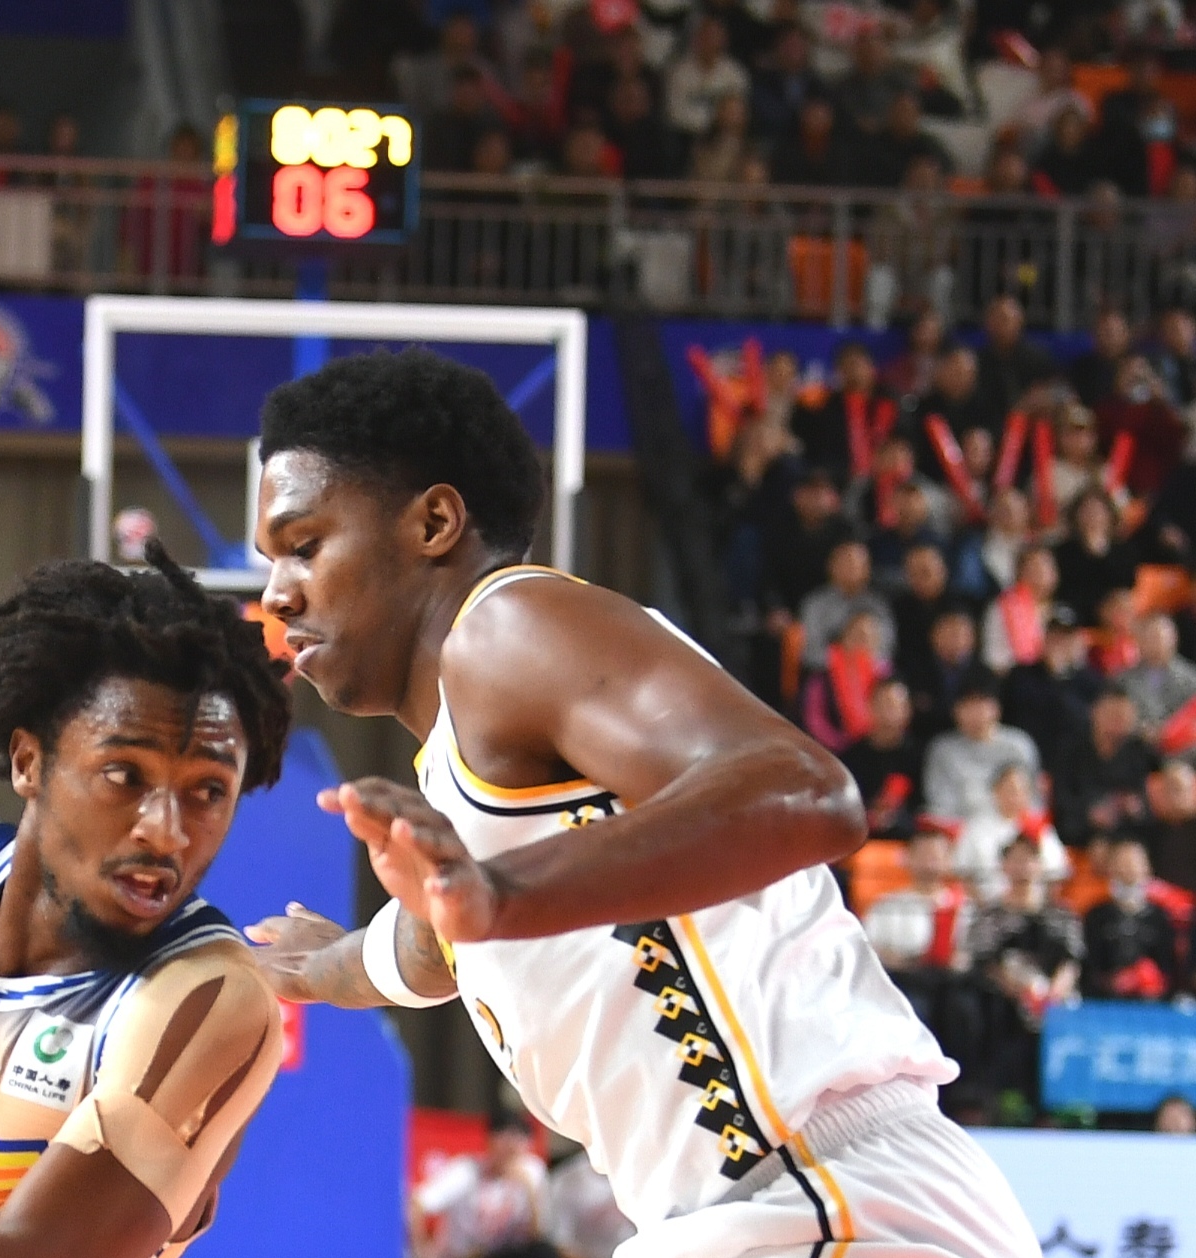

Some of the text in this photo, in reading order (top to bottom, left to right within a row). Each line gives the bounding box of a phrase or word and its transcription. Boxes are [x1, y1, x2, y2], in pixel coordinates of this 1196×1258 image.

[273, 165, 375, 239] 06
[8, 1078, 66, 1103] CHINA LIFE
[12, 1064, 71, 1092] 中国人寿
